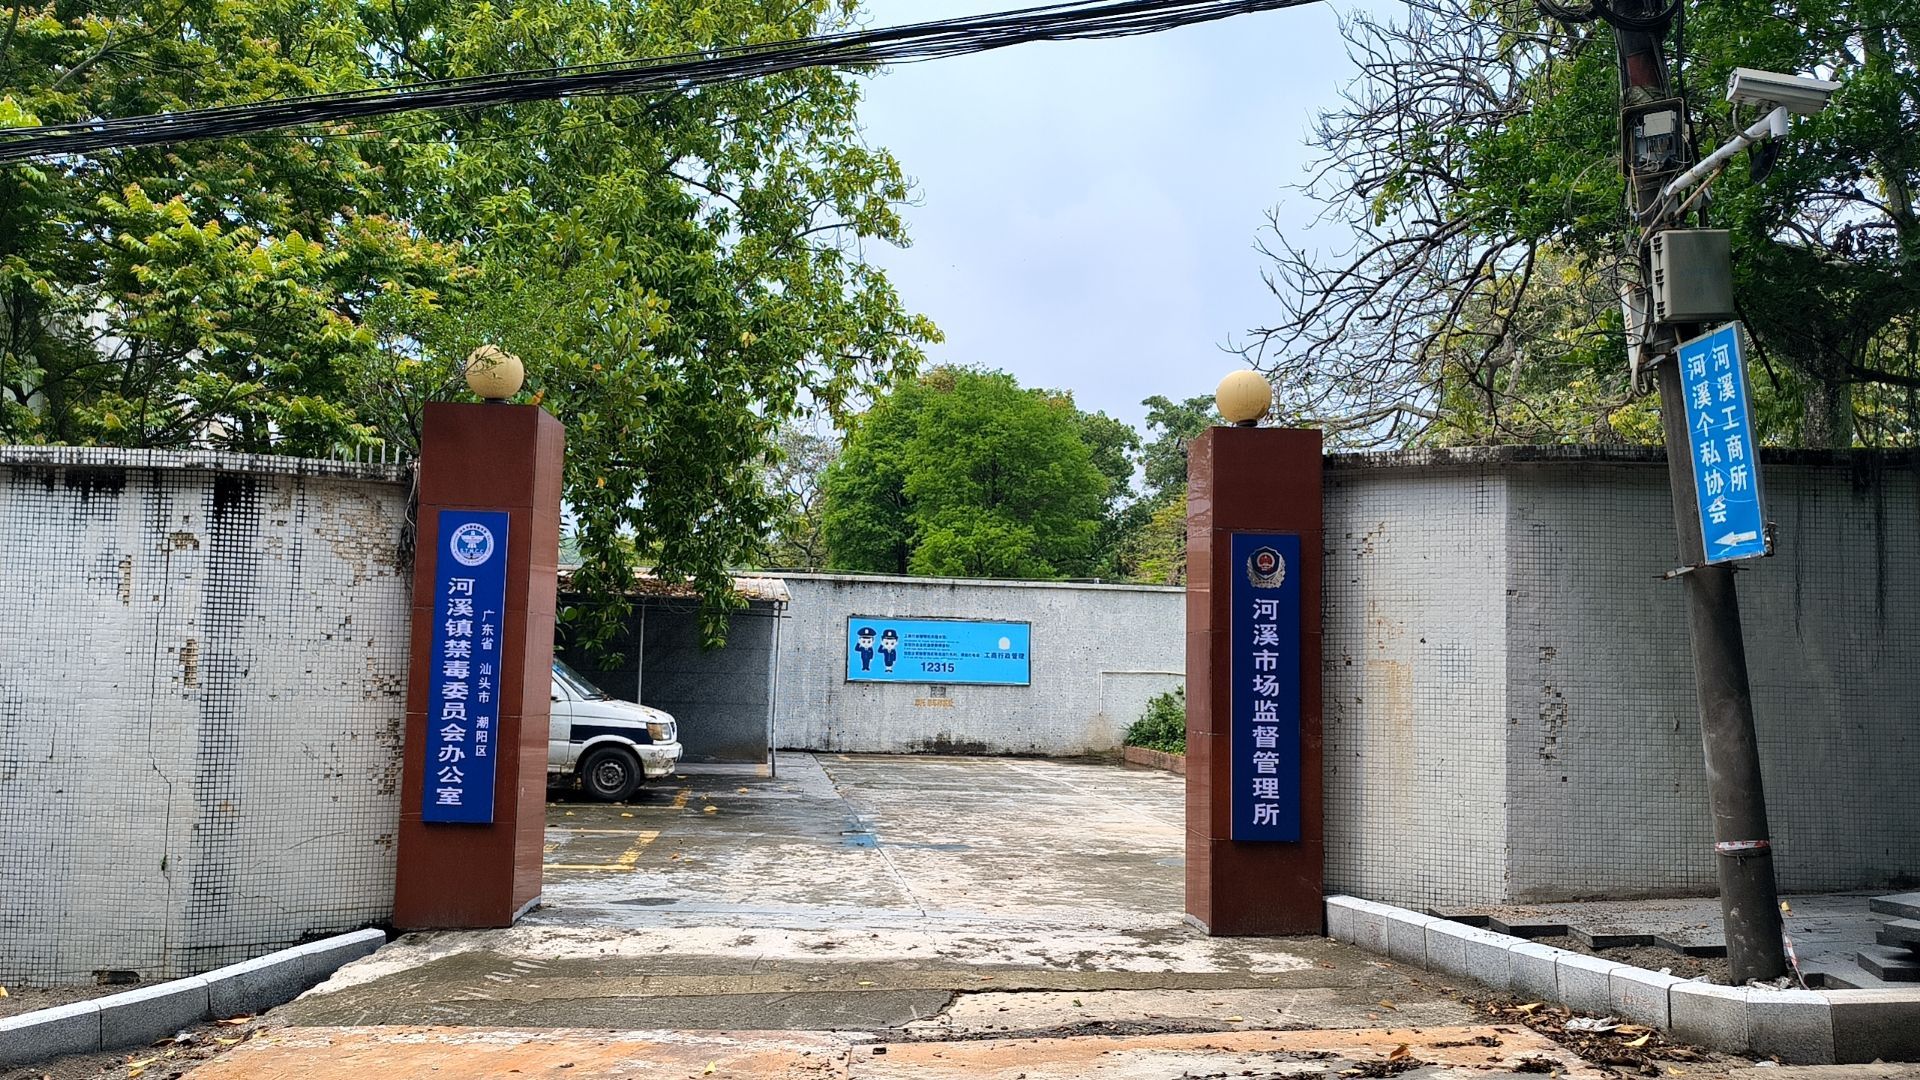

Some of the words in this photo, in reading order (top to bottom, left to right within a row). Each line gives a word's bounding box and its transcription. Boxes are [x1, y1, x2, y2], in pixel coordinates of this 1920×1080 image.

[1687, 352, 1727, 525] 河溪个私协会
[1712, 342, 1748, 493] 河溪工商所
[481, 609, 495, 650] 广东省
[920, 662, 955, 673] 12315
[436, 577, 476, 805] 河溪镇禁毒委员会办公室
[477, 662, 492, 704] 汕头市
[1252, 598, 1280, 826] 河溪市场监督管理所
[475, 716, 489, 757] 潮阳区
